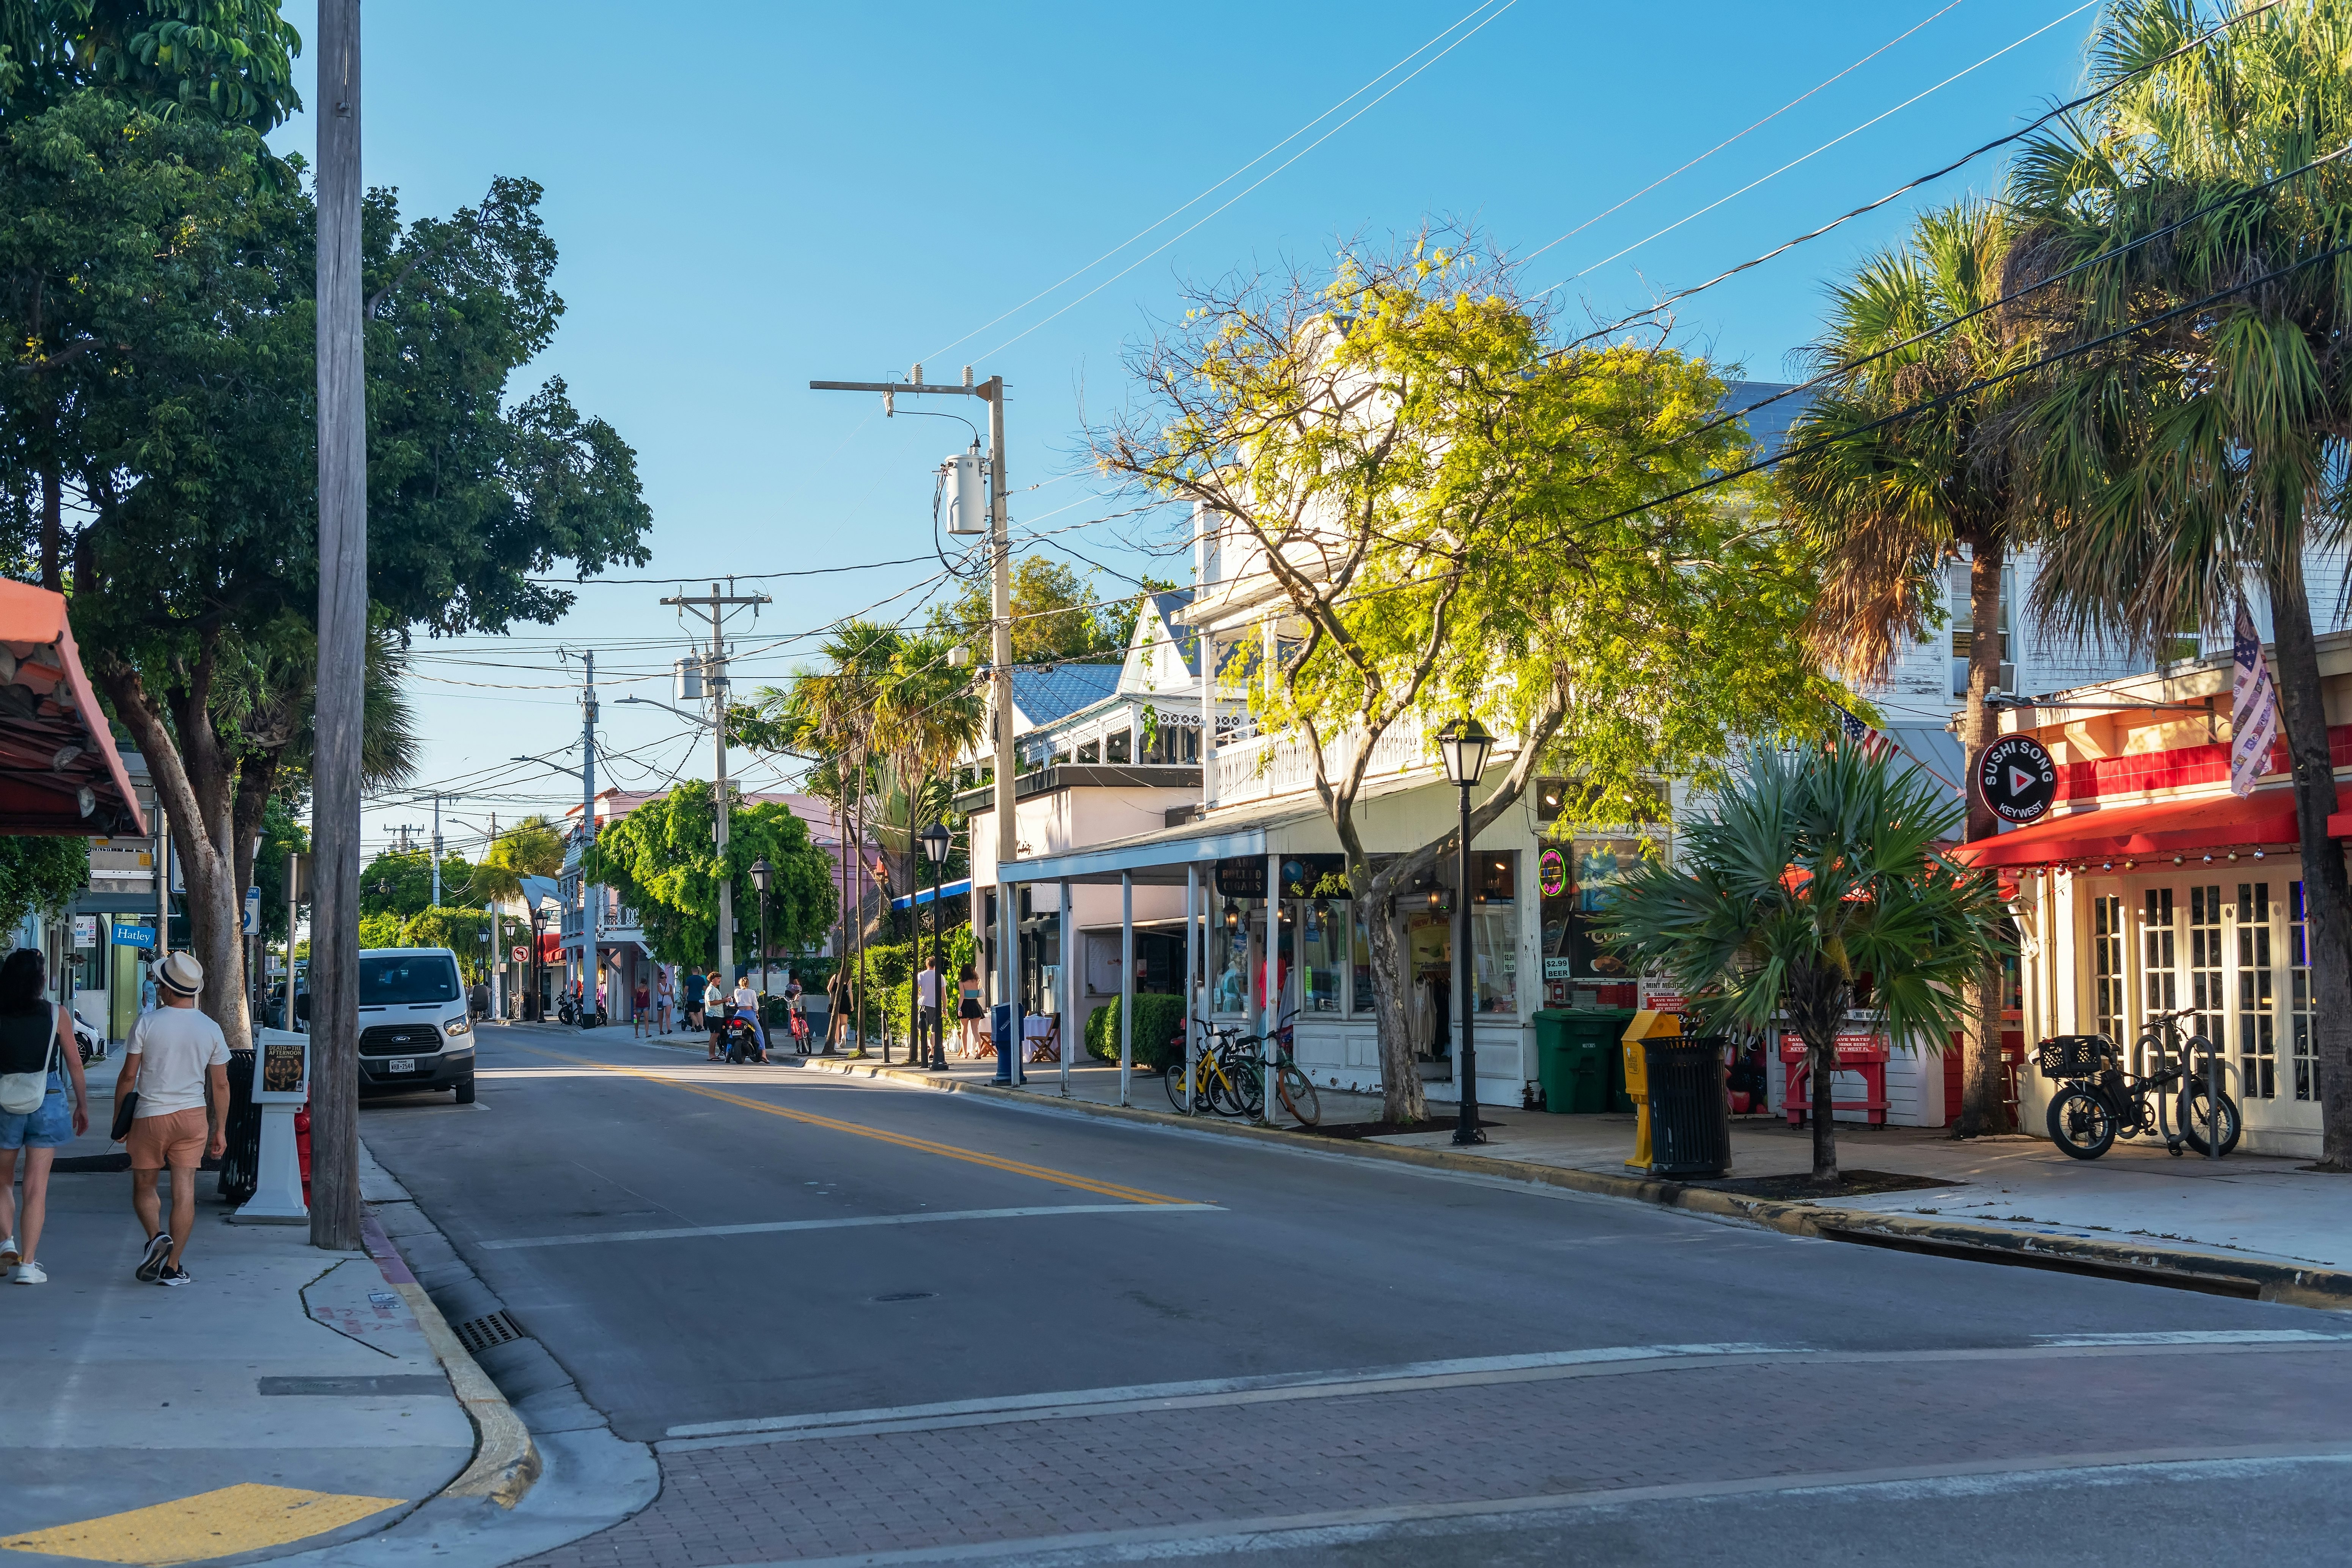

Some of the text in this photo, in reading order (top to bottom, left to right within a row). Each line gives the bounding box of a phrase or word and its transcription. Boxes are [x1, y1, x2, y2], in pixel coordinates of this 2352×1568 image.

[1985, 742, 2053, 785] SUSHI SONG
[1999, 800, 2043, 818] KEY WEST
[1228, 859, 1256, 867] HAND
[1542, 851, 1561, 865] PREMIUM
[1222, 870, 1261, 879] ROLLED
[1223, 882, 1261, 891] CIGARS
[1544, 882, 1561, 894] CIGARS
[117, 928, 150, 943] Hatley
